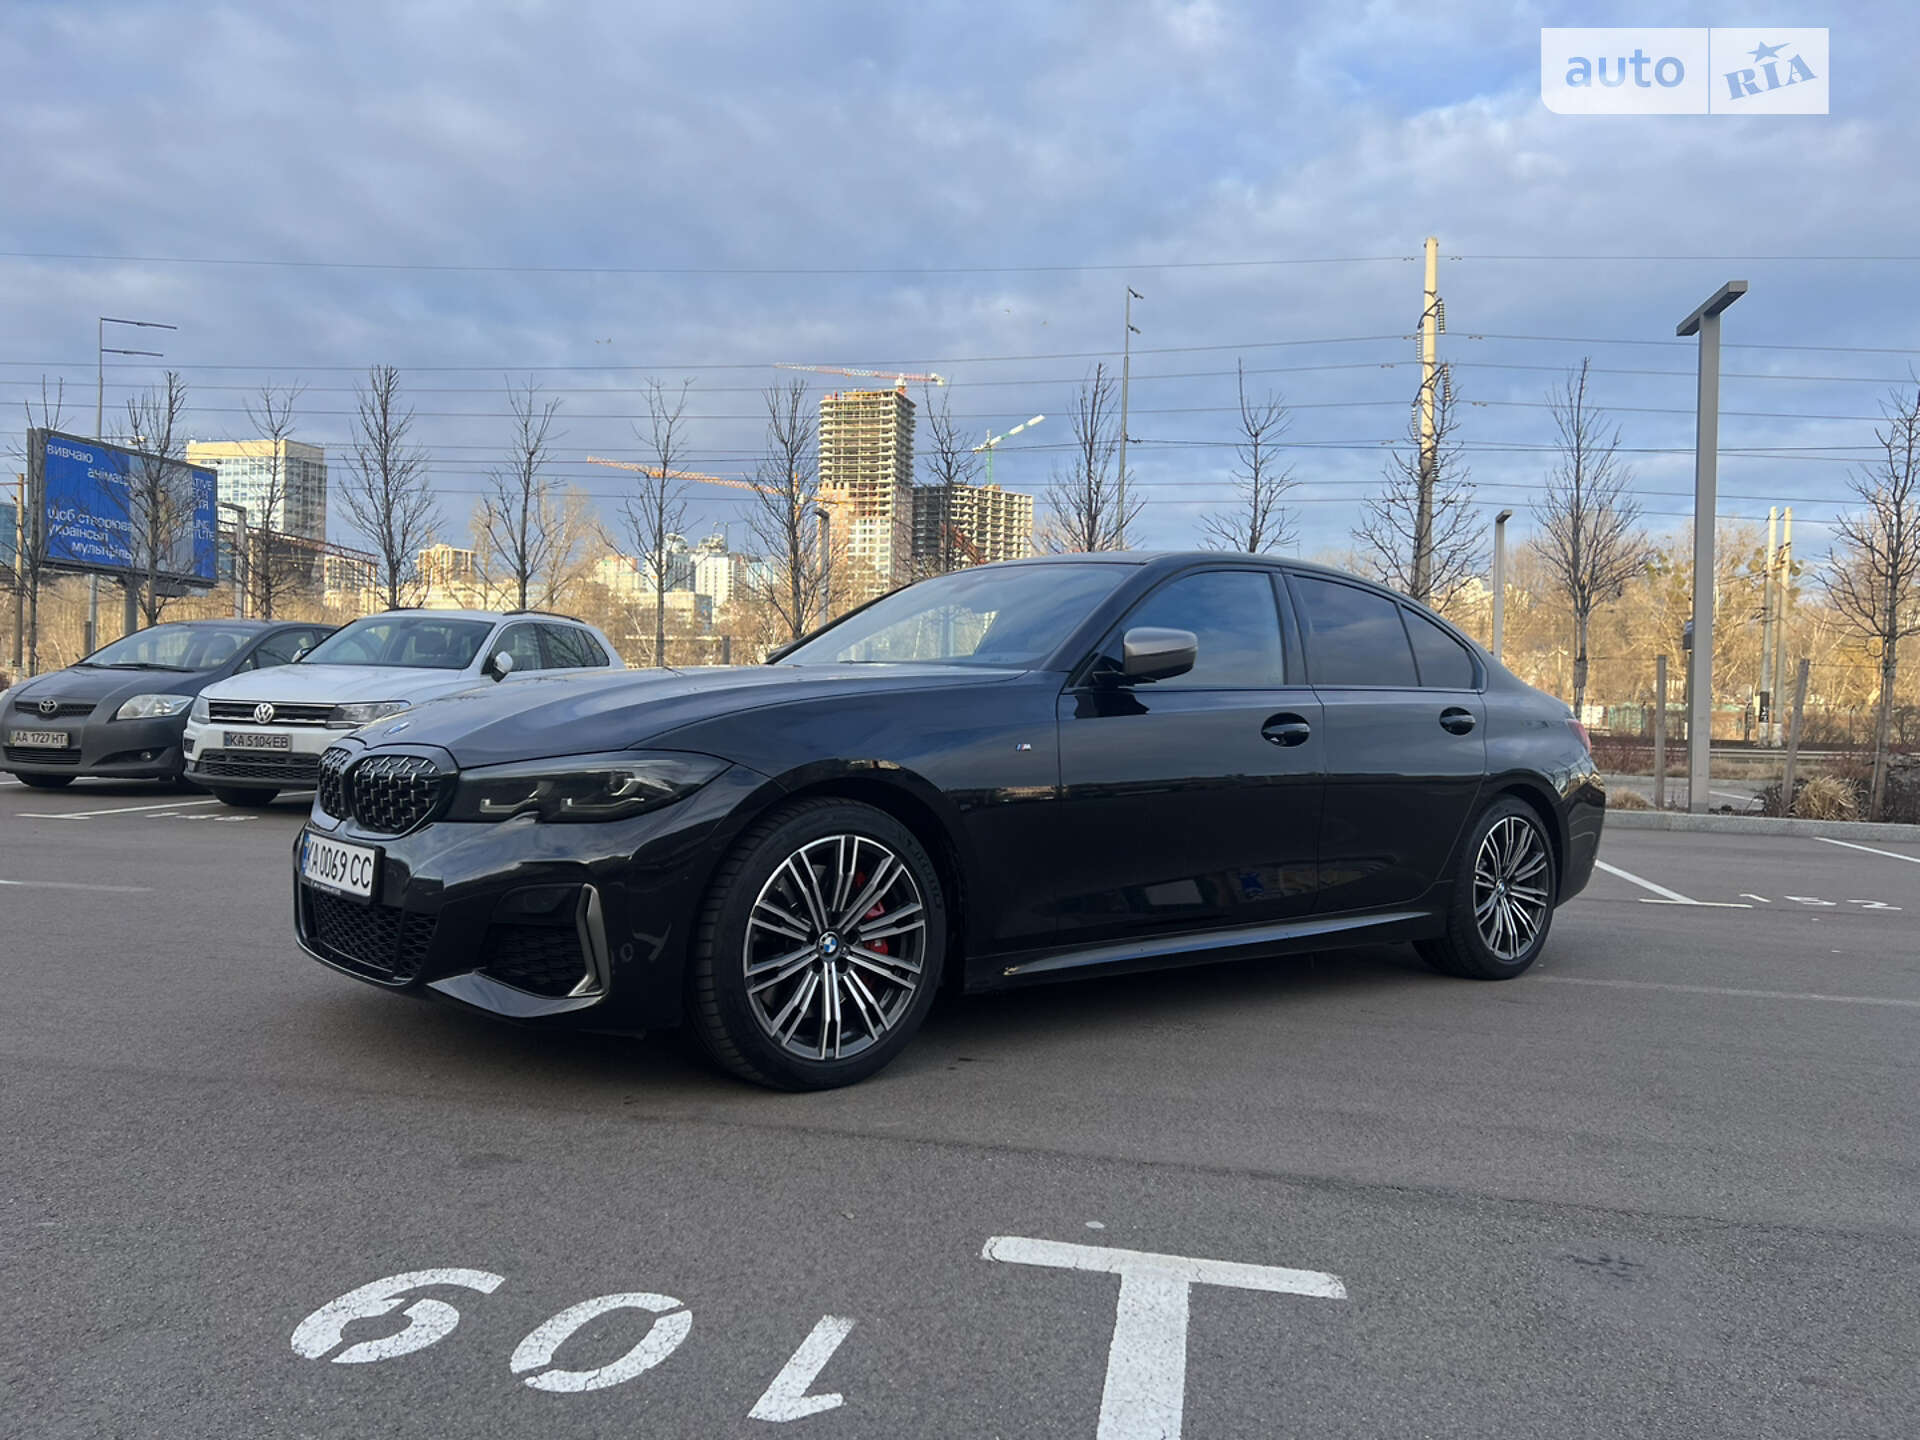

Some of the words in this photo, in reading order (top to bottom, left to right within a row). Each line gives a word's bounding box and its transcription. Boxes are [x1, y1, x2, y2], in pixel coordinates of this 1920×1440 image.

[46, 443, 94, 464] вивчаю
[47, 507, 75, 522] щоб
[78, 513, 140, 535] створюва
[320, 845, 348, 883] 0069
[350, 853, 372, 889] CC
